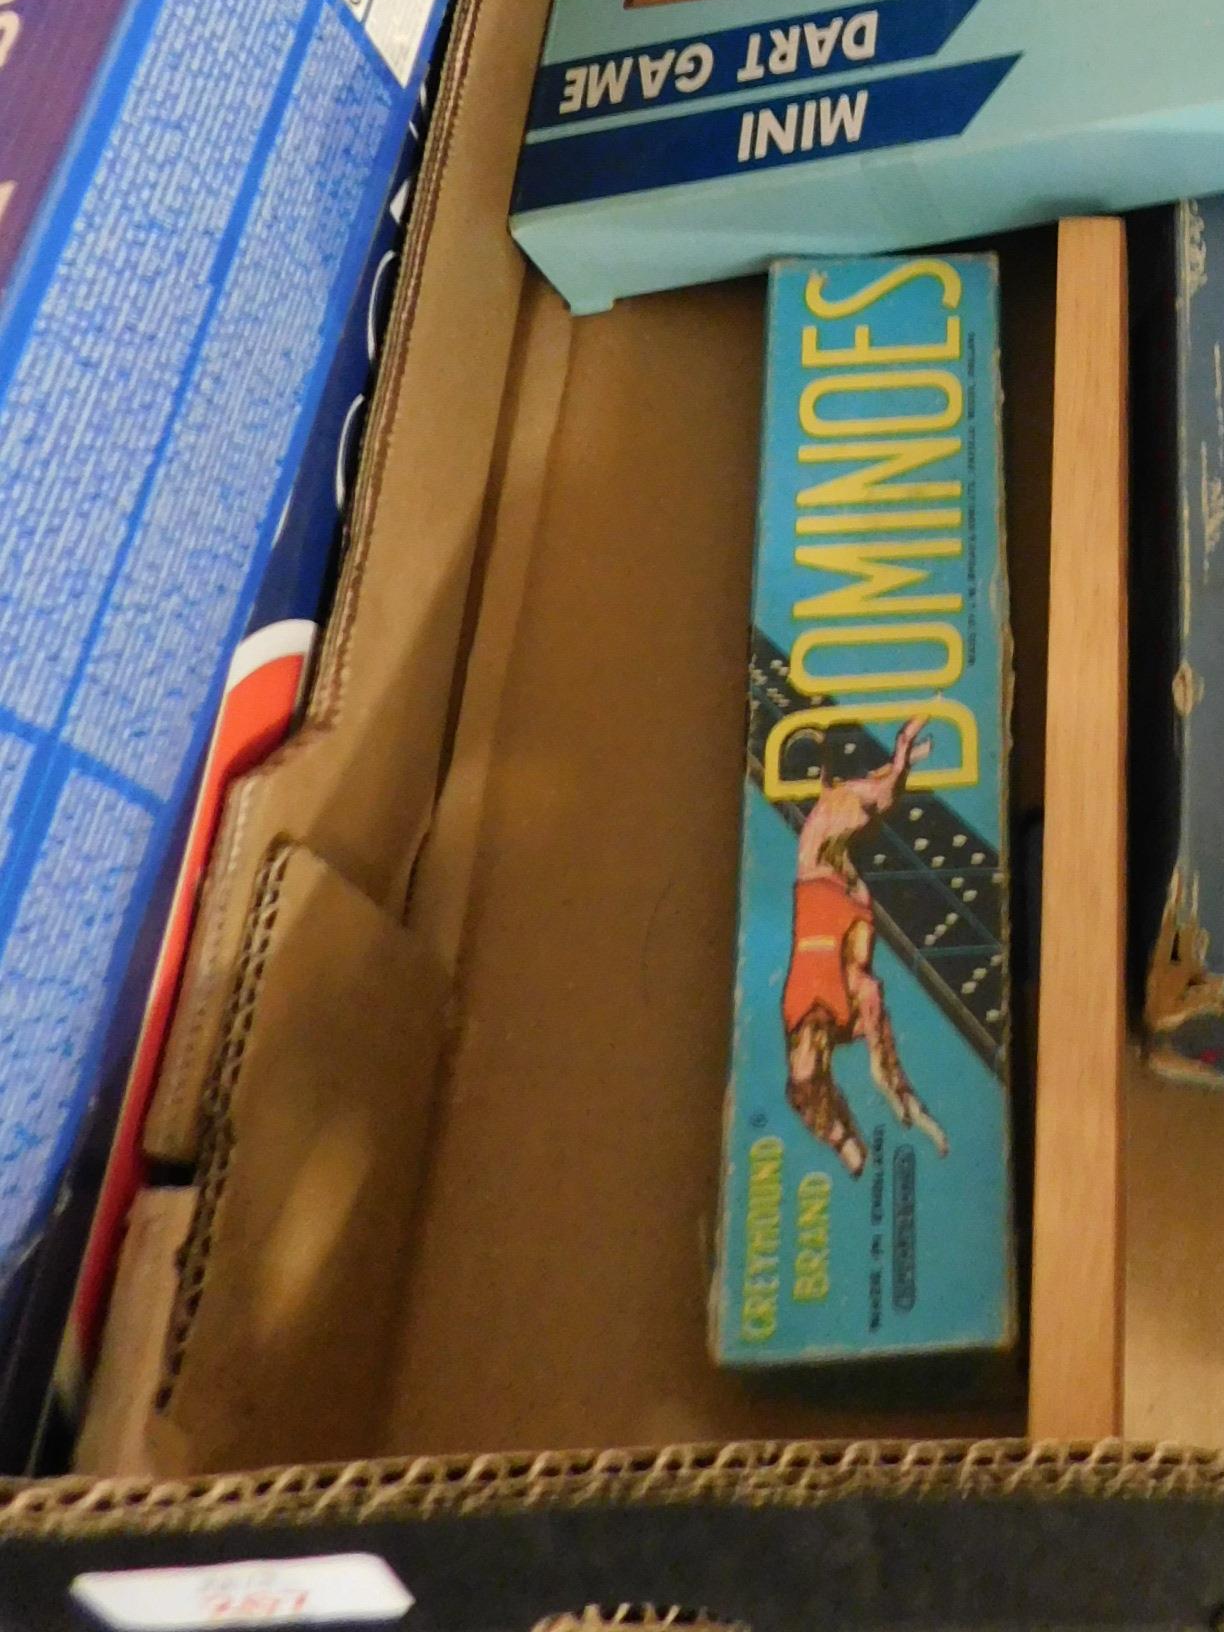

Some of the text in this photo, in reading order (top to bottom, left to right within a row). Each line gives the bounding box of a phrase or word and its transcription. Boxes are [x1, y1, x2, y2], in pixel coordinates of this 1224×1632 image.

[557, 9, 879, 115] DART GAME
[738, 89, 869, 163] MINI
[763, 258, 979, 802] DOMINOES
[741, 1135, 785, 1344] GREYHOUND
[792, 1171, 833, 1305] BRAND
